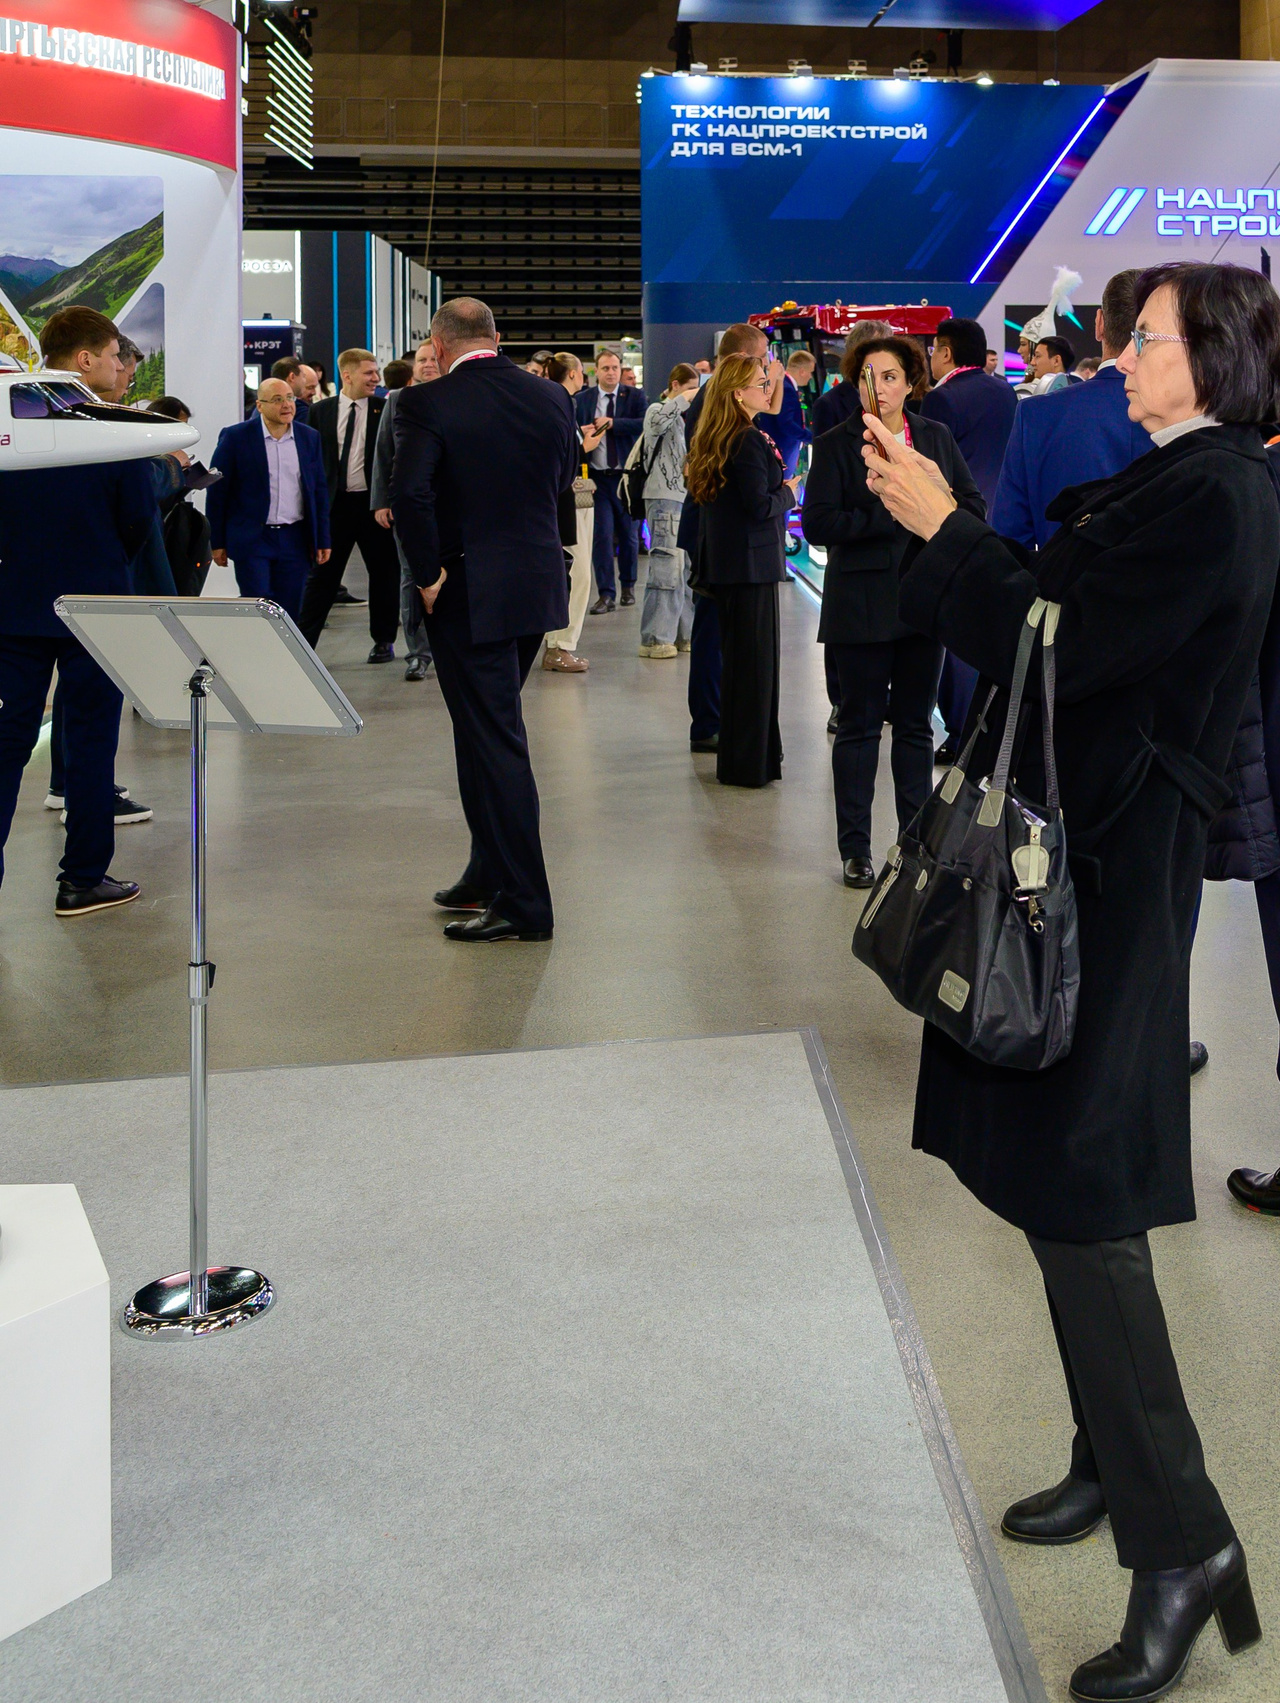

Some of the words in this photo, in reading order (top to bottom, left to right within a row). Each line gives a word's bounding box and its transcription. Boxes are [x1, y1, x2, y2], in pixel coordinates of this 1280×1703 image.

[0, 18, 137, 73] РГЫЗСКАЯ
[671, 104, 830, 120] ТЕХНОЛОГИИ
[671, 124, 701, 137] ГК
[707, 123, 928, 140] НАЦПРОЕКТСТРОЙ
[670, 142, 724, 157] ДЛЯ
[731, 143, 802, 156] ВСМ-1
[254, 341, 282, 349] КРЭТ
